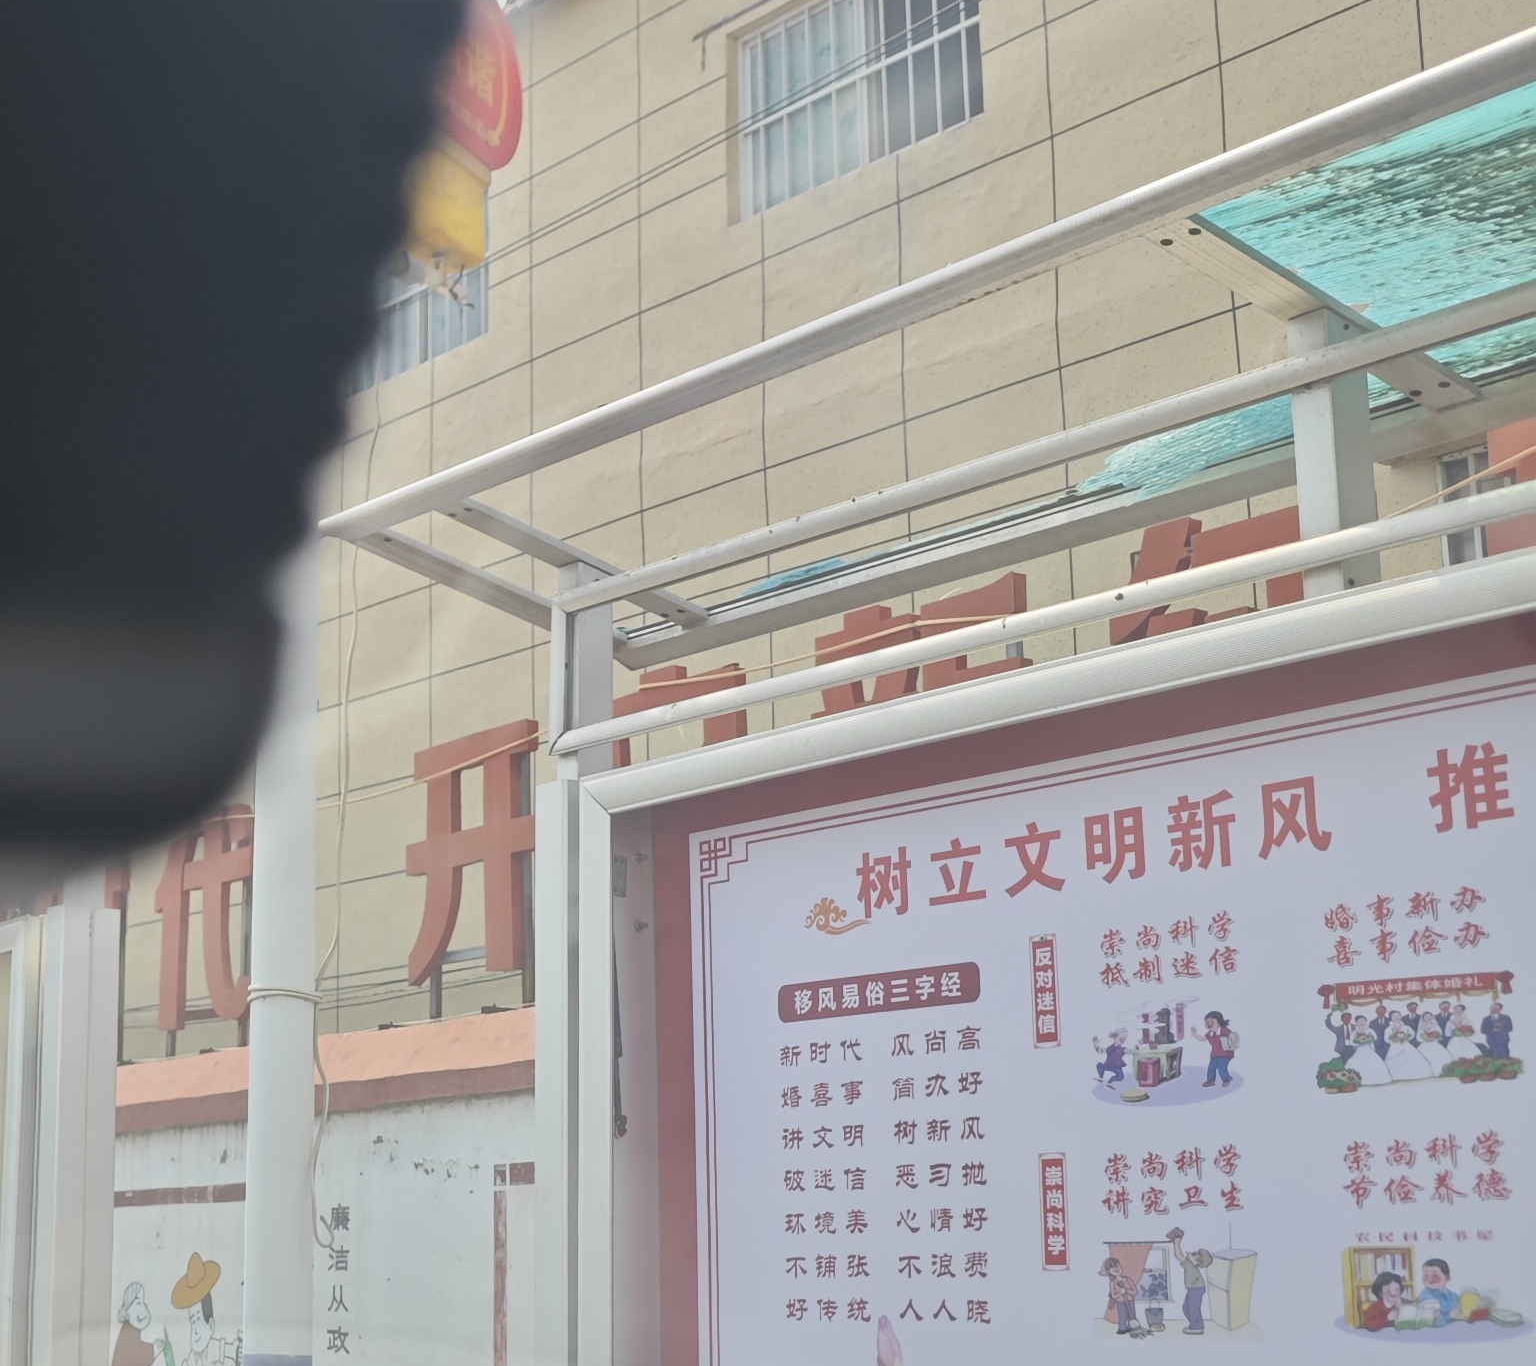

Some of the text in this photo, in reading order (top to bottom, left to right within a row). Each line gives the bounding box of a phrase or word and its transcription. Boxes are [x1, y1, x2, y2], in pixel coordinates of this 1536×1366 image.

[855, 740, 1516, 920] 树立文明新风 推
[1324, 886, 1486, 932] 婚事新办
[1099, 909, 1235, 958] 崇尚科学
[1327, 921, 1490, 968] 喜事俭办
[1099, 946, 1239, 988] 抵制迷信
[793, 971, 963, 1016] 移风易俗三字经
[1034, 946, 1056, 1035] 反对迷信
[780, 1025, 982, 1067] 新时代 风尚高
[781, 1071, 984, 1109] 婚喜事 简办好
[782, 1116, 986, 1150] 讲文明 树新风
[1343, 1130, 1504, 1172] 崇尚科学
[783, 1161, 988, 1192] 破迷信 恶习抛
[1104, 1143, 1241, 1185] 崇尚科学
[1101, 1181, 1244, 1219] 讲究卫生
[1342, 1168, 1512, 1209] 节俭养德
[785, 1207, 988, 1235] 环境美 心情好
[1044, 1165, 1066, 1257] 崇尚科学
[785, 1251, 989, 1279] 不铺张 不浪费
[786, 1298, 992, 1324] 好传统 人人晓
